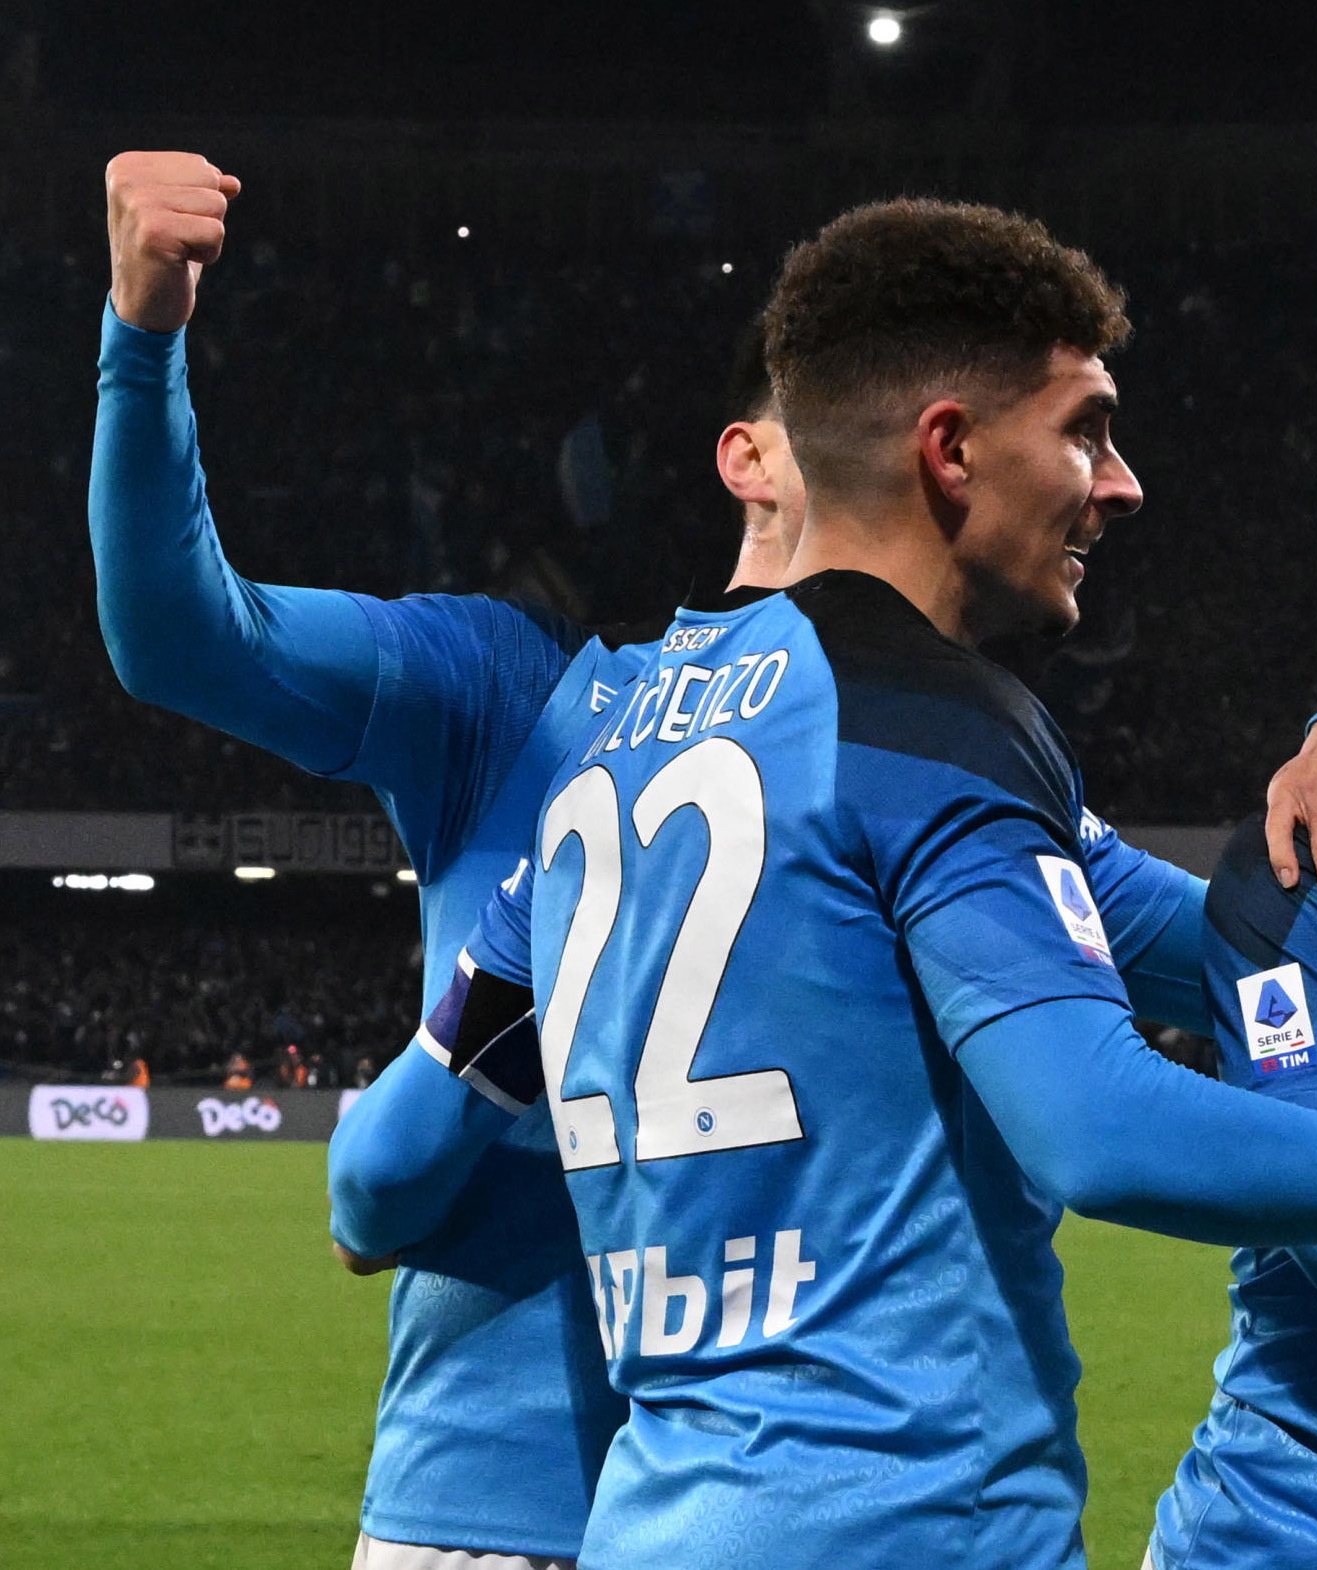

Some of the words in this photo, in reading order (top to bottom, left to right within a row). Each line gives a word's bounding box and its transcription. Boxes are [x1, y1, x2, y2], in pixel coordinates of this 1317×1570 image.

[541, 736, 806, 1172] 22
[1257, 1030, 1292, 1047] SERIE
[1295, 1028, 1304, 1039] A
[1279, 1051, 1310, 1069] TIM
